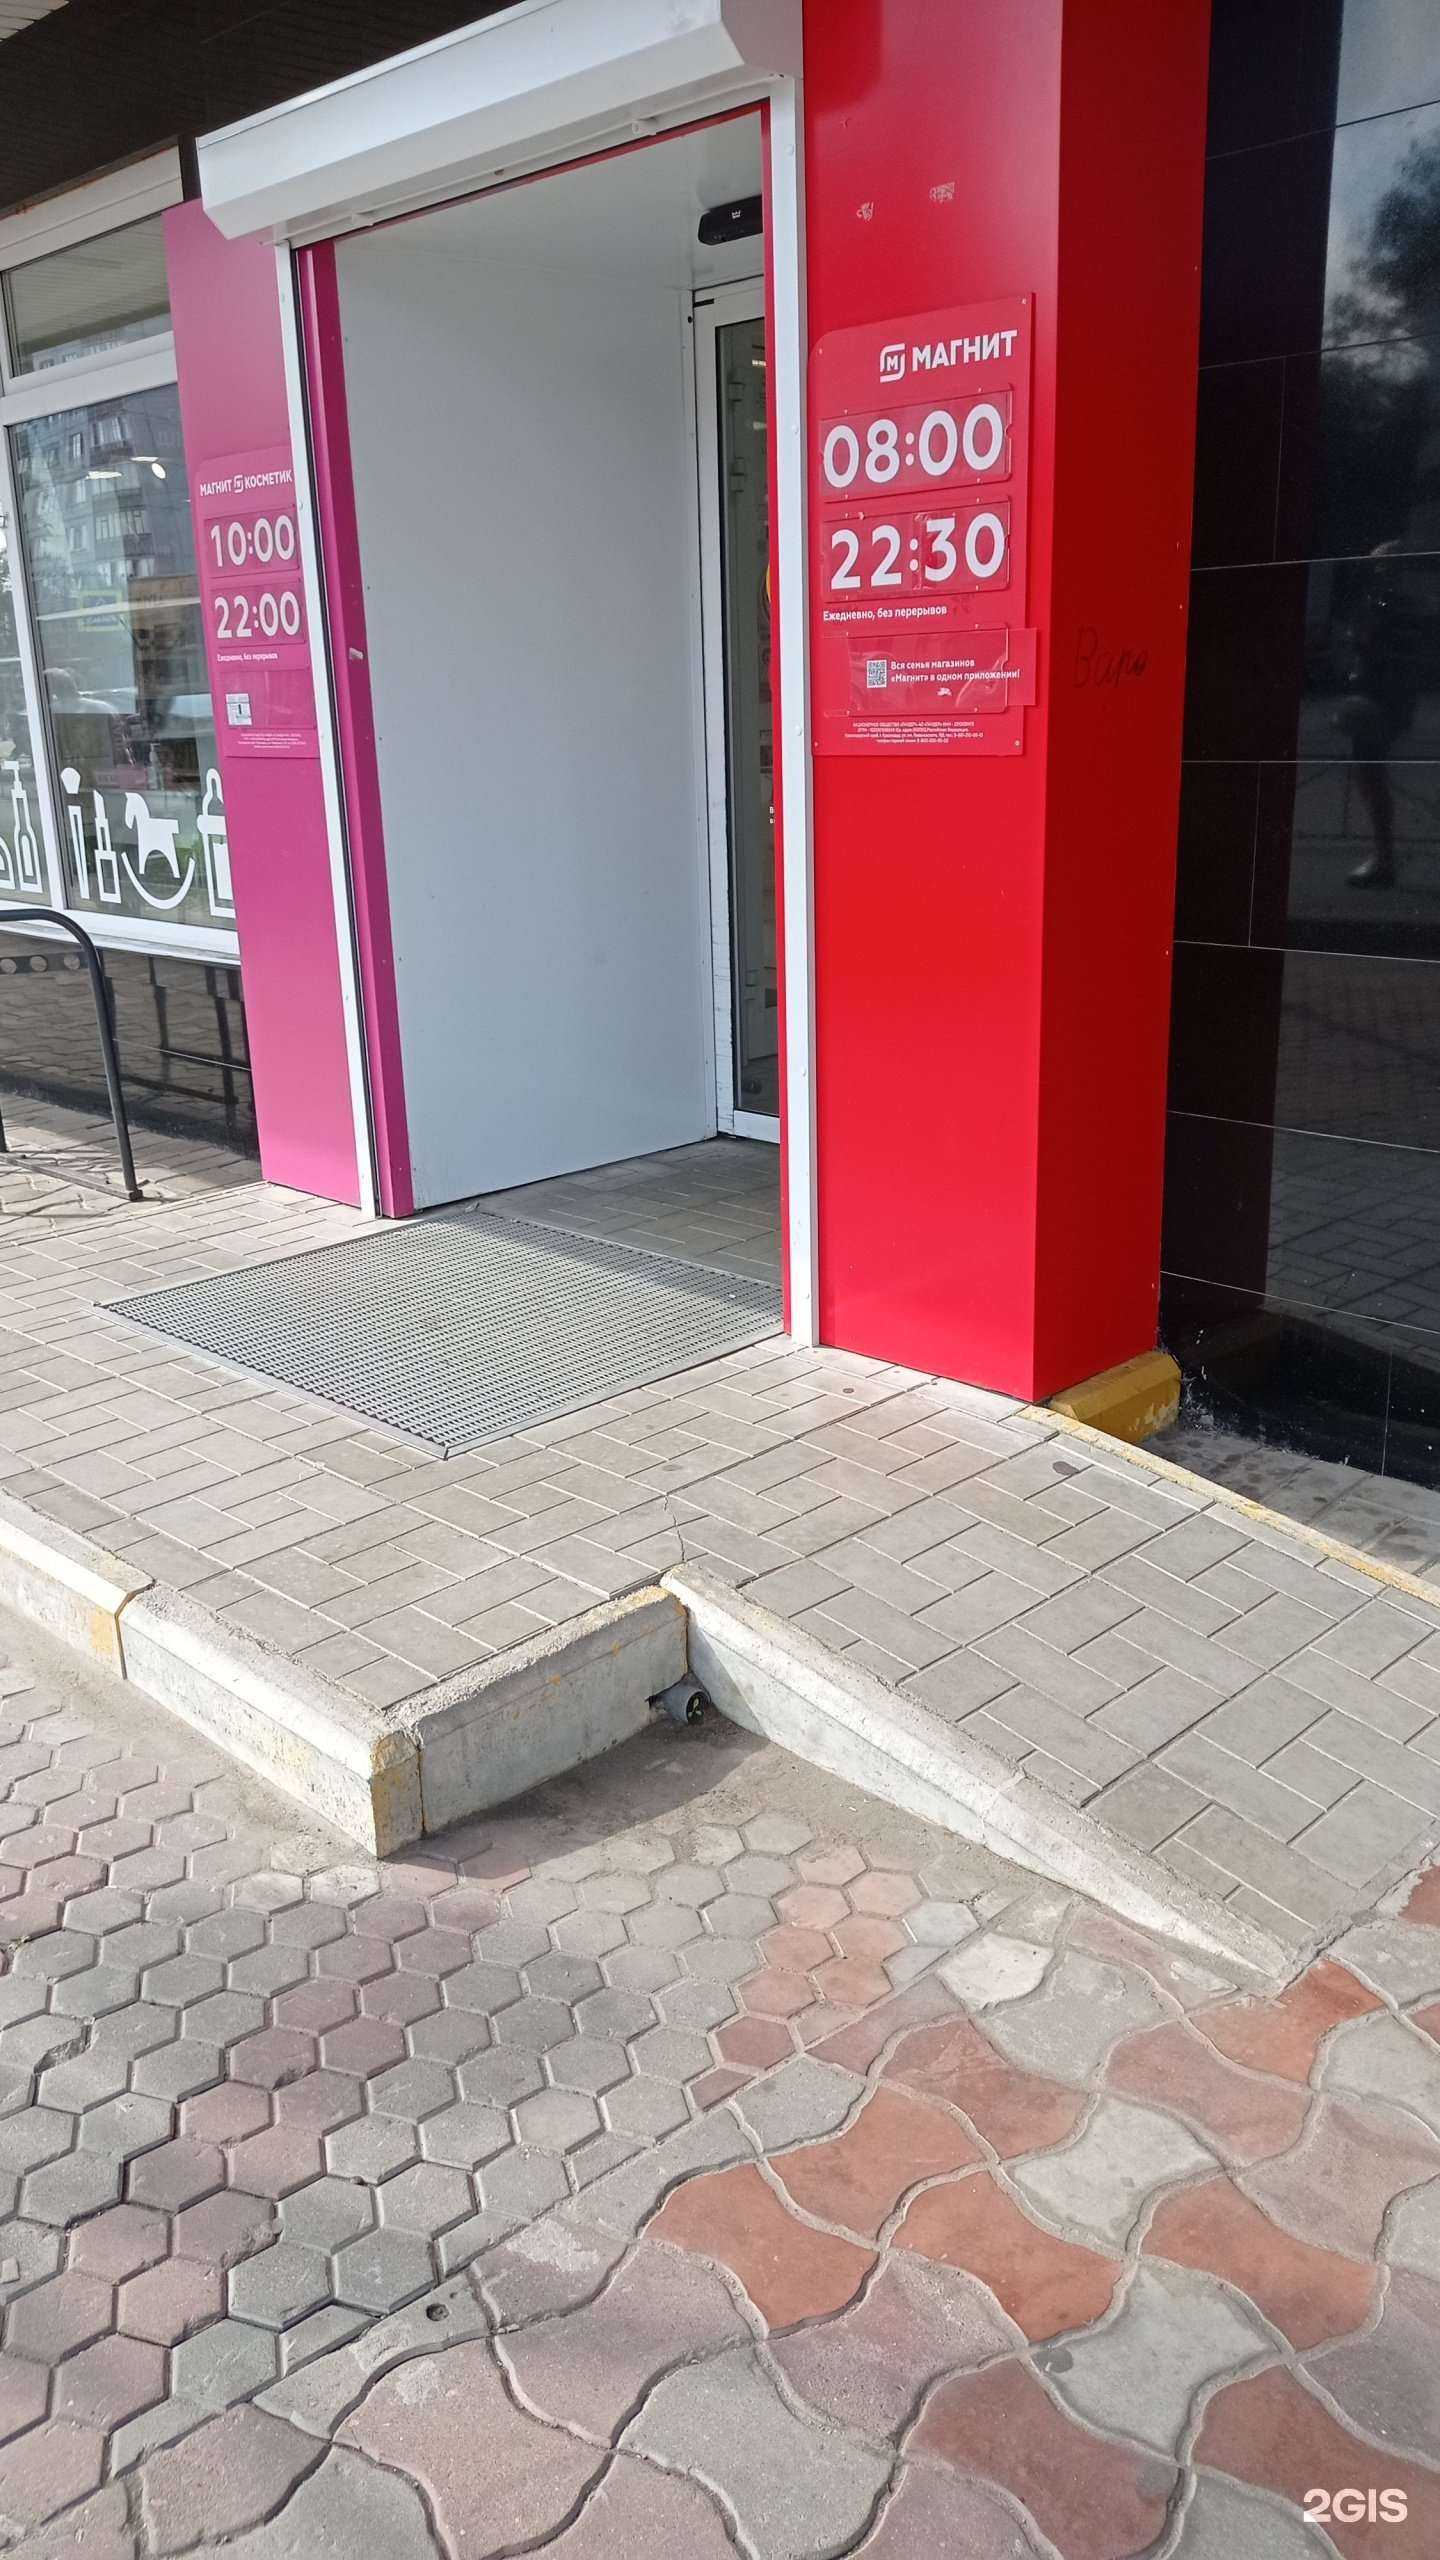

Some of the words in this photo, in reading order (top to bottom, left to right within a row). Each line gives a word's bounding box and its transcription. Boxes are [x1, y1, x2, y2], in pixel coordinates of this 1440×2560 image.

[911, 329, 1018, 372] МАГНИТ
[823, 403, 1003, 488] 08:00
[200, 480, 233, 497] МАГНИТ
[243, 469, 293, 490] КОСМЕТИК
[210, 515, 295, 568] 10:00
[830, 512, 1006, 590] 22:30
[214, 591, 300, 639] 22:00
[823, 608, 876, 622] Ежедневно,
[877, 606, 893, 618] без
[895, 605, 947, 619] перерывов
[890, 660, 906, 670] Вся
[906, 661, 930, 670] семья
[931, 659, 975, 670] магазинов
[891, 673, 929, 683] «Магнит»
[936, 671, 964, 682] одном
[964, 668, 1021, 682] приложении!
